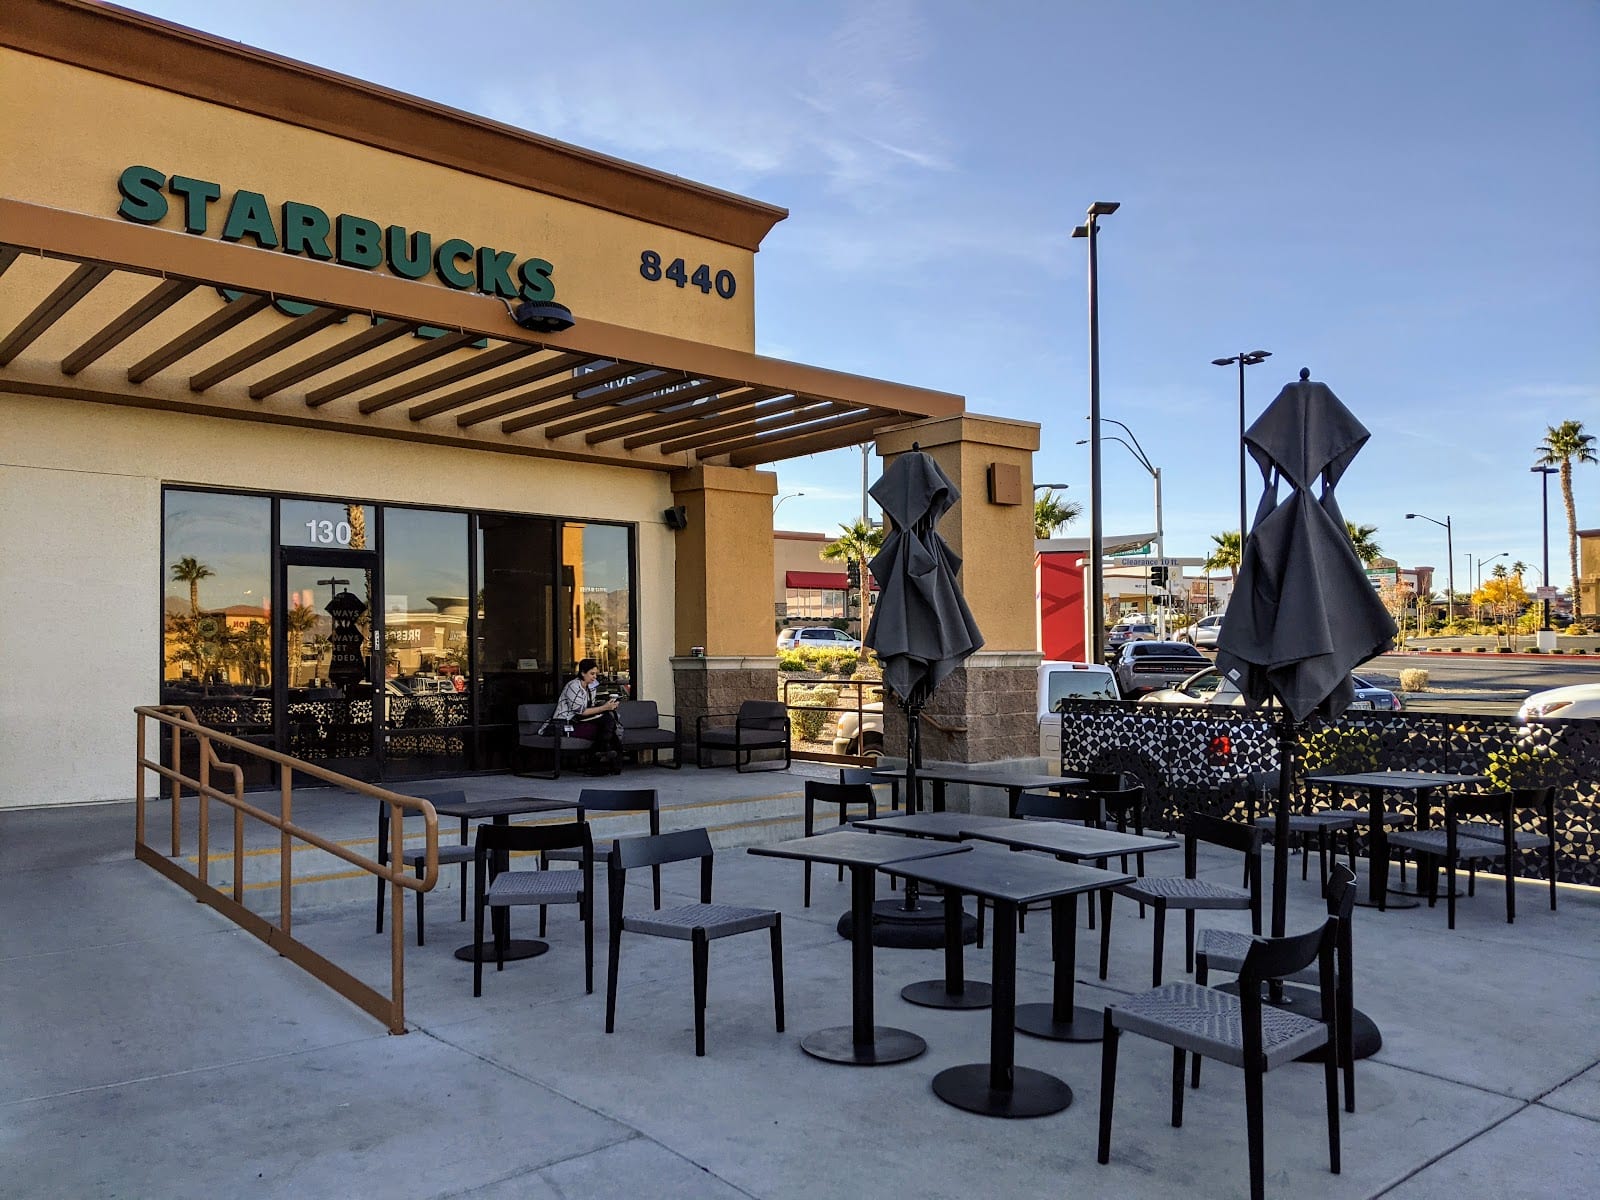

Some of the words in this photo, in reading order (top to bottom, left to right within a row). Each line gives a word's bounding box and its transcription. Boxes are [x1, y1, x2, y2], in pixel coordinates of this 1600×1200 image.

[117, 165, 556, 302] STARBUCKS
[640, 250, 736, 299] 8440
[305, 519, 352, 545] 130
[1121, 558, 1158, 566] Clearance
[1160, 558, 1170, 566] 10
[332, 609, 360, 617] WAYS
